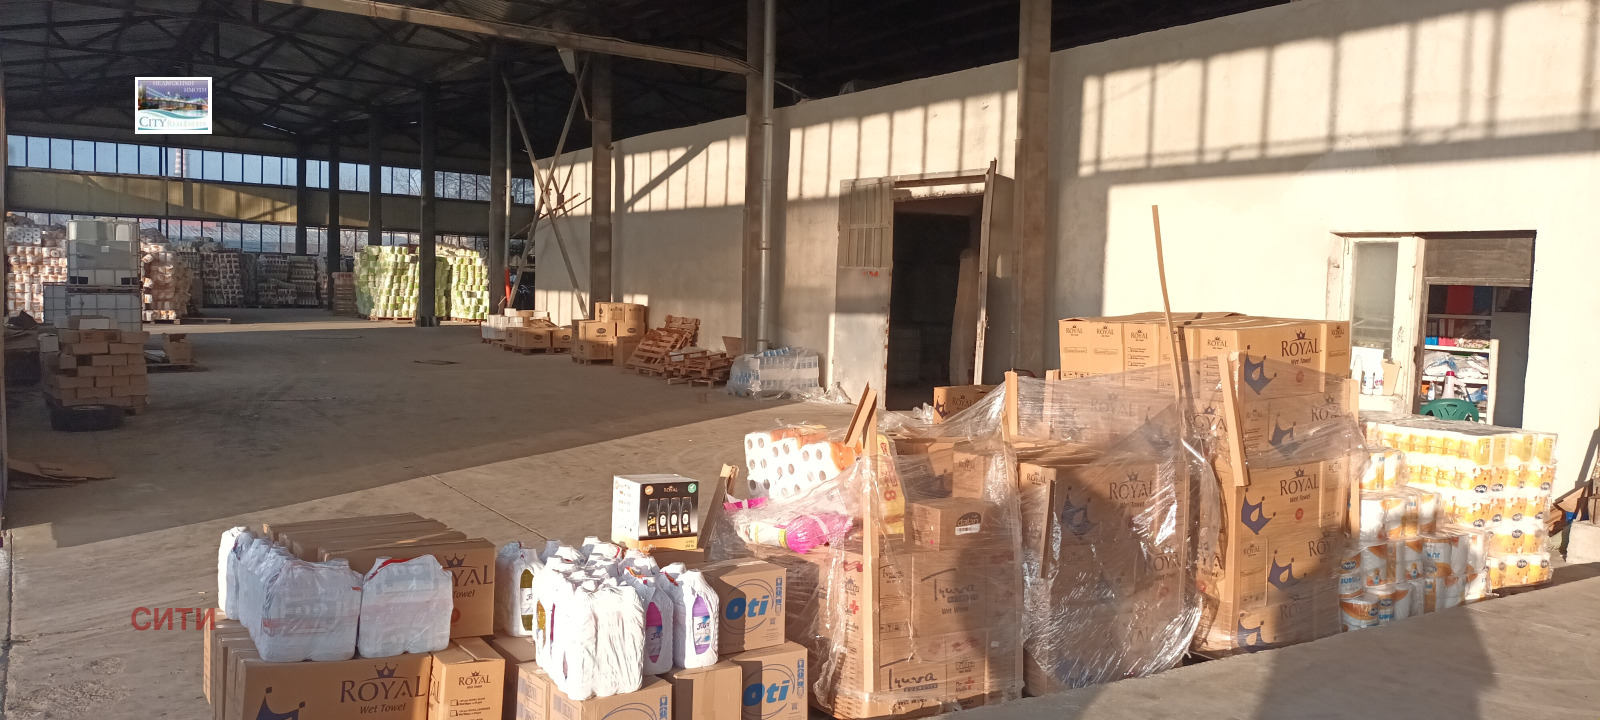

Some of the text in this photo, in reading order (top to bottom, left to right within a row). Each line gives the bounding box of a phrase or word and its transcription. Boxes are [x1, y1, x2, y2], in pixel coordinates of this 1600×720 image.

[1065, 326, 1083, 334] ROYAL
[1096, 327, 1114, 336] ROYAL
[1130, 331, 1149, 340] ROYAL
[1207, 338, 1228, 347] ROYAL
[1281, 338, 1319, 357] ROYAL
[1109, 480, 1153, 500] ROYAL
[1280, 474, 1319, 496] ROYAL
[452, 565, 494, 587] YAL
[458, 676, 491, 686] ROYAL
[340, 675, 425, 703] ROYAL
[360, 702, 407, 715] Wet Towel
